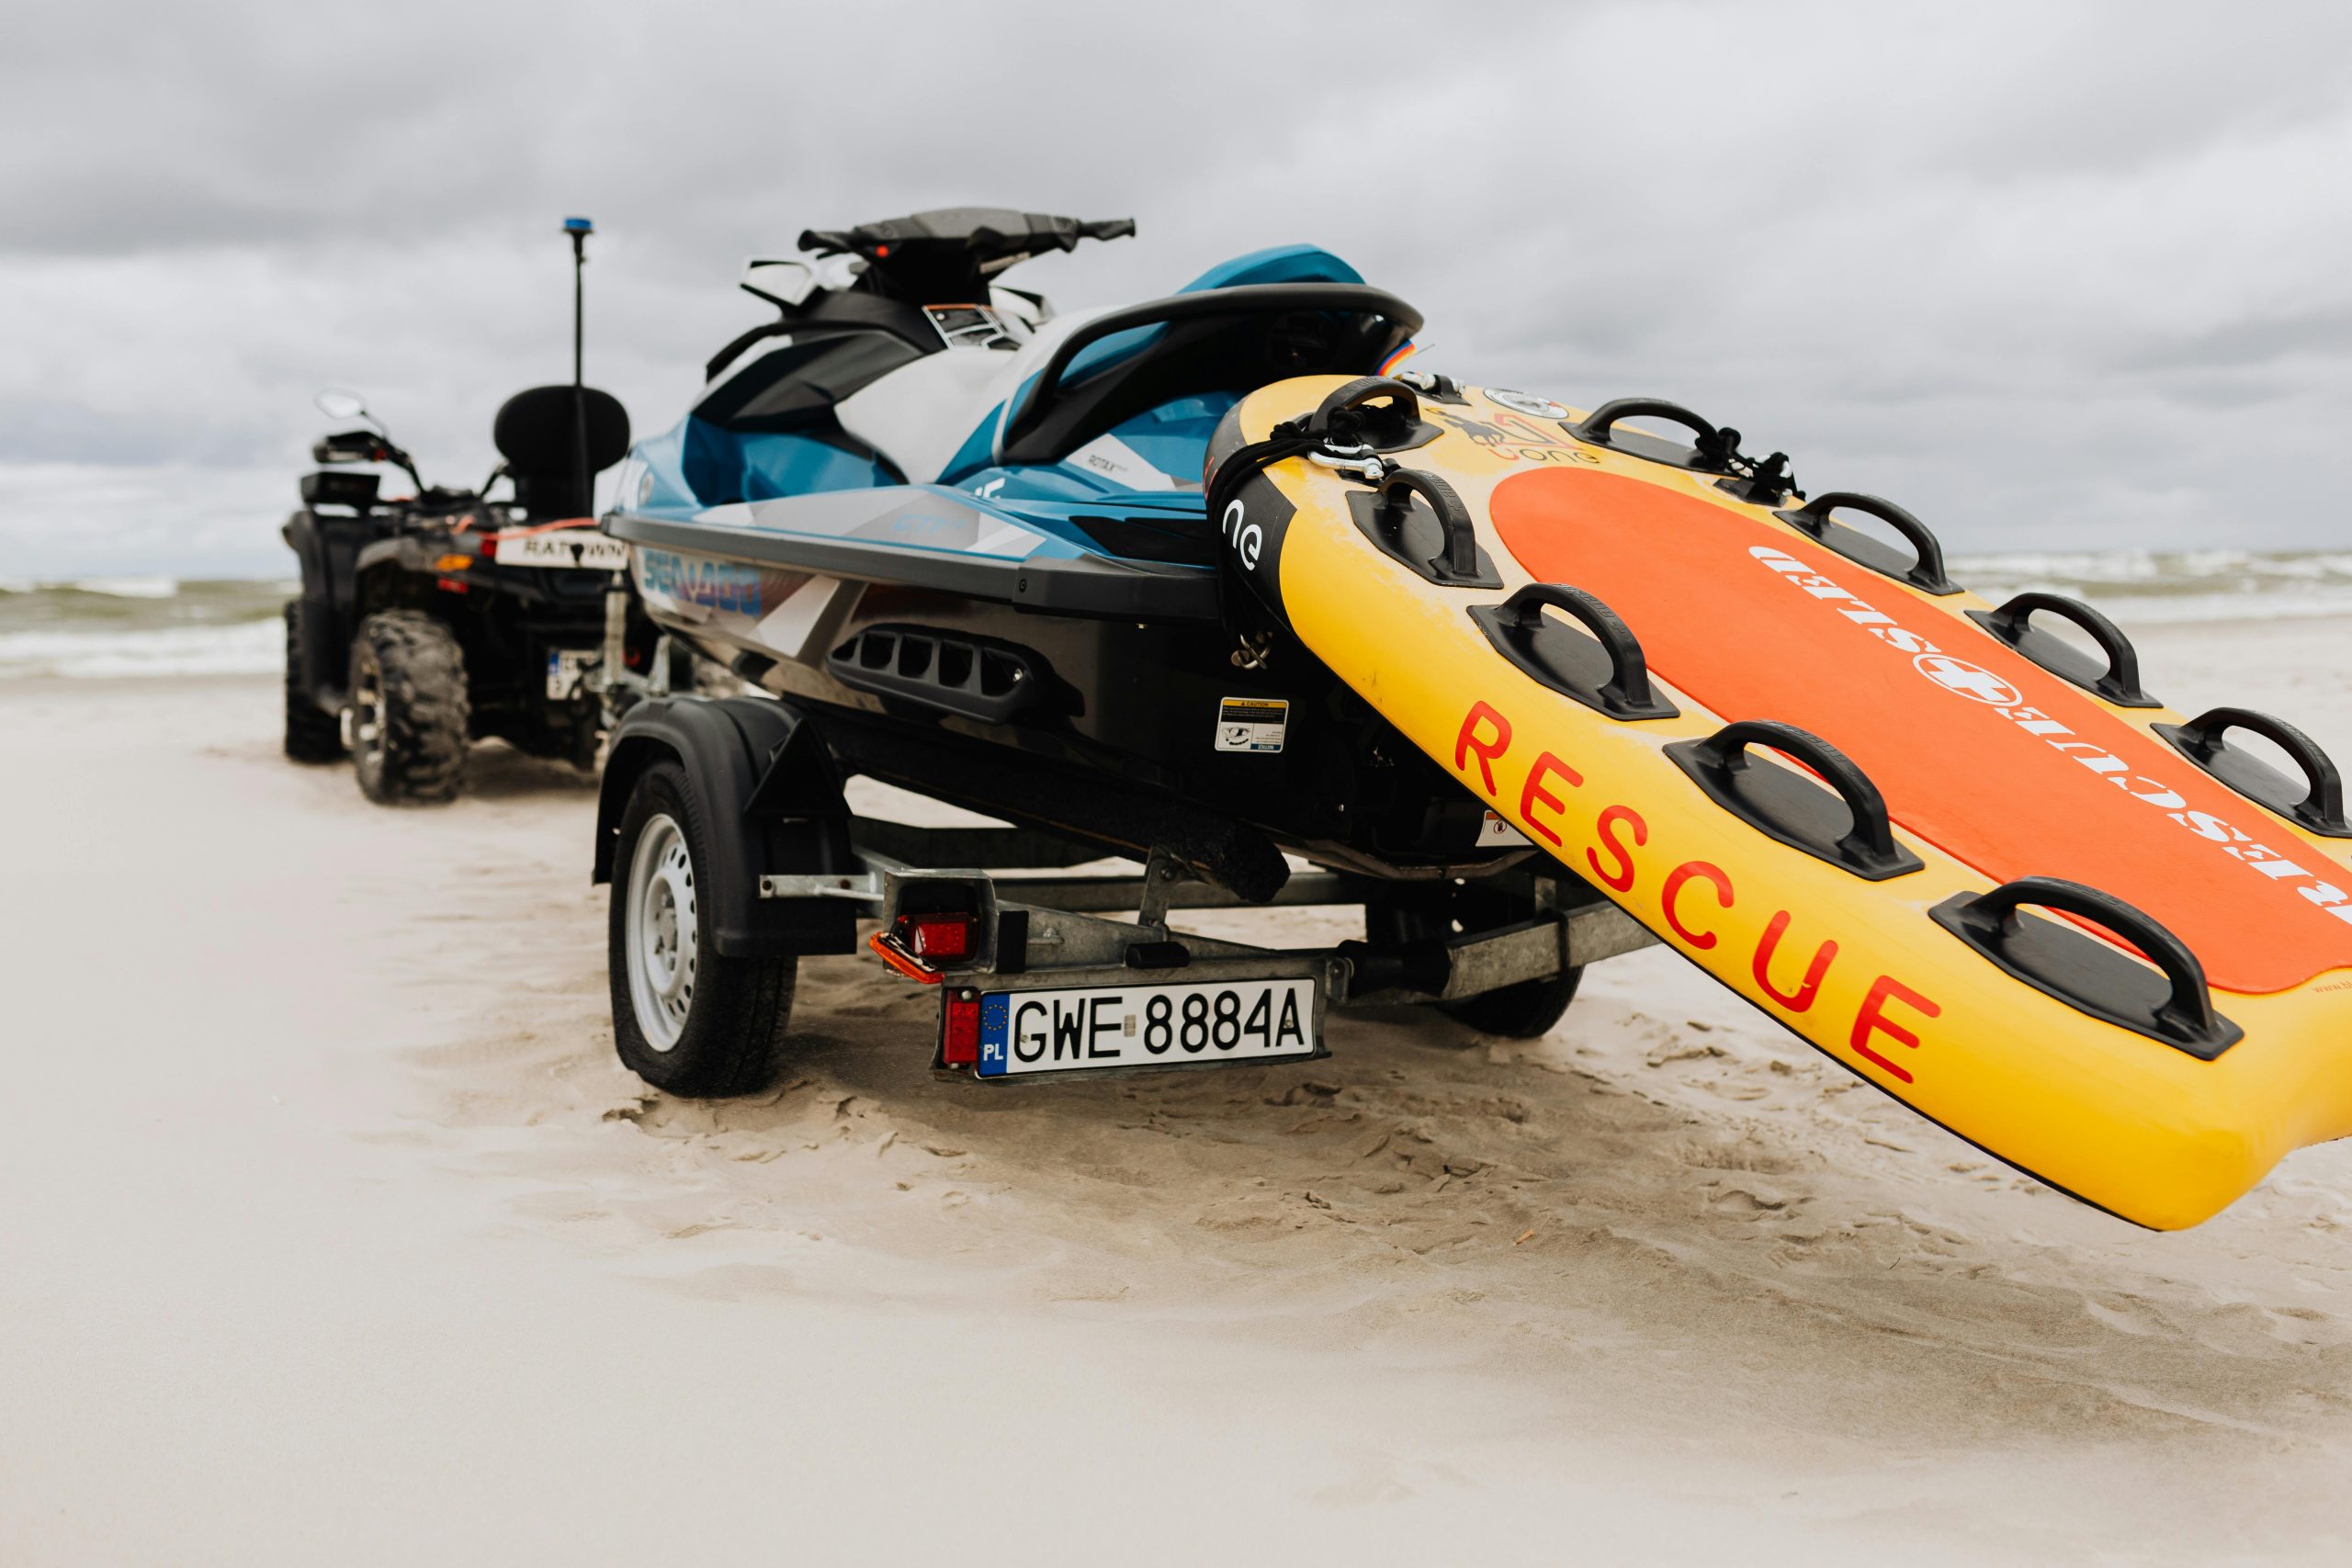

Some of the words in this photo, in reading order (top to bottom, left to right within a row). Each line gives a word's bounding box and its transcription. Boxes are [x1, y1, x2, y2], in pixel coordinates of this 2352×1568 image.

[1748, 546, 1941, 653] SLED
[1994, 707, 2352, 925] RESCUE
[1454, 700, 1941, 1085] RESCUE
[983, 1043, 1003, 1061] PL
[1013, 996, 1123, 1063] GWE
[1144, 987, 1305, 1055] 8884A
